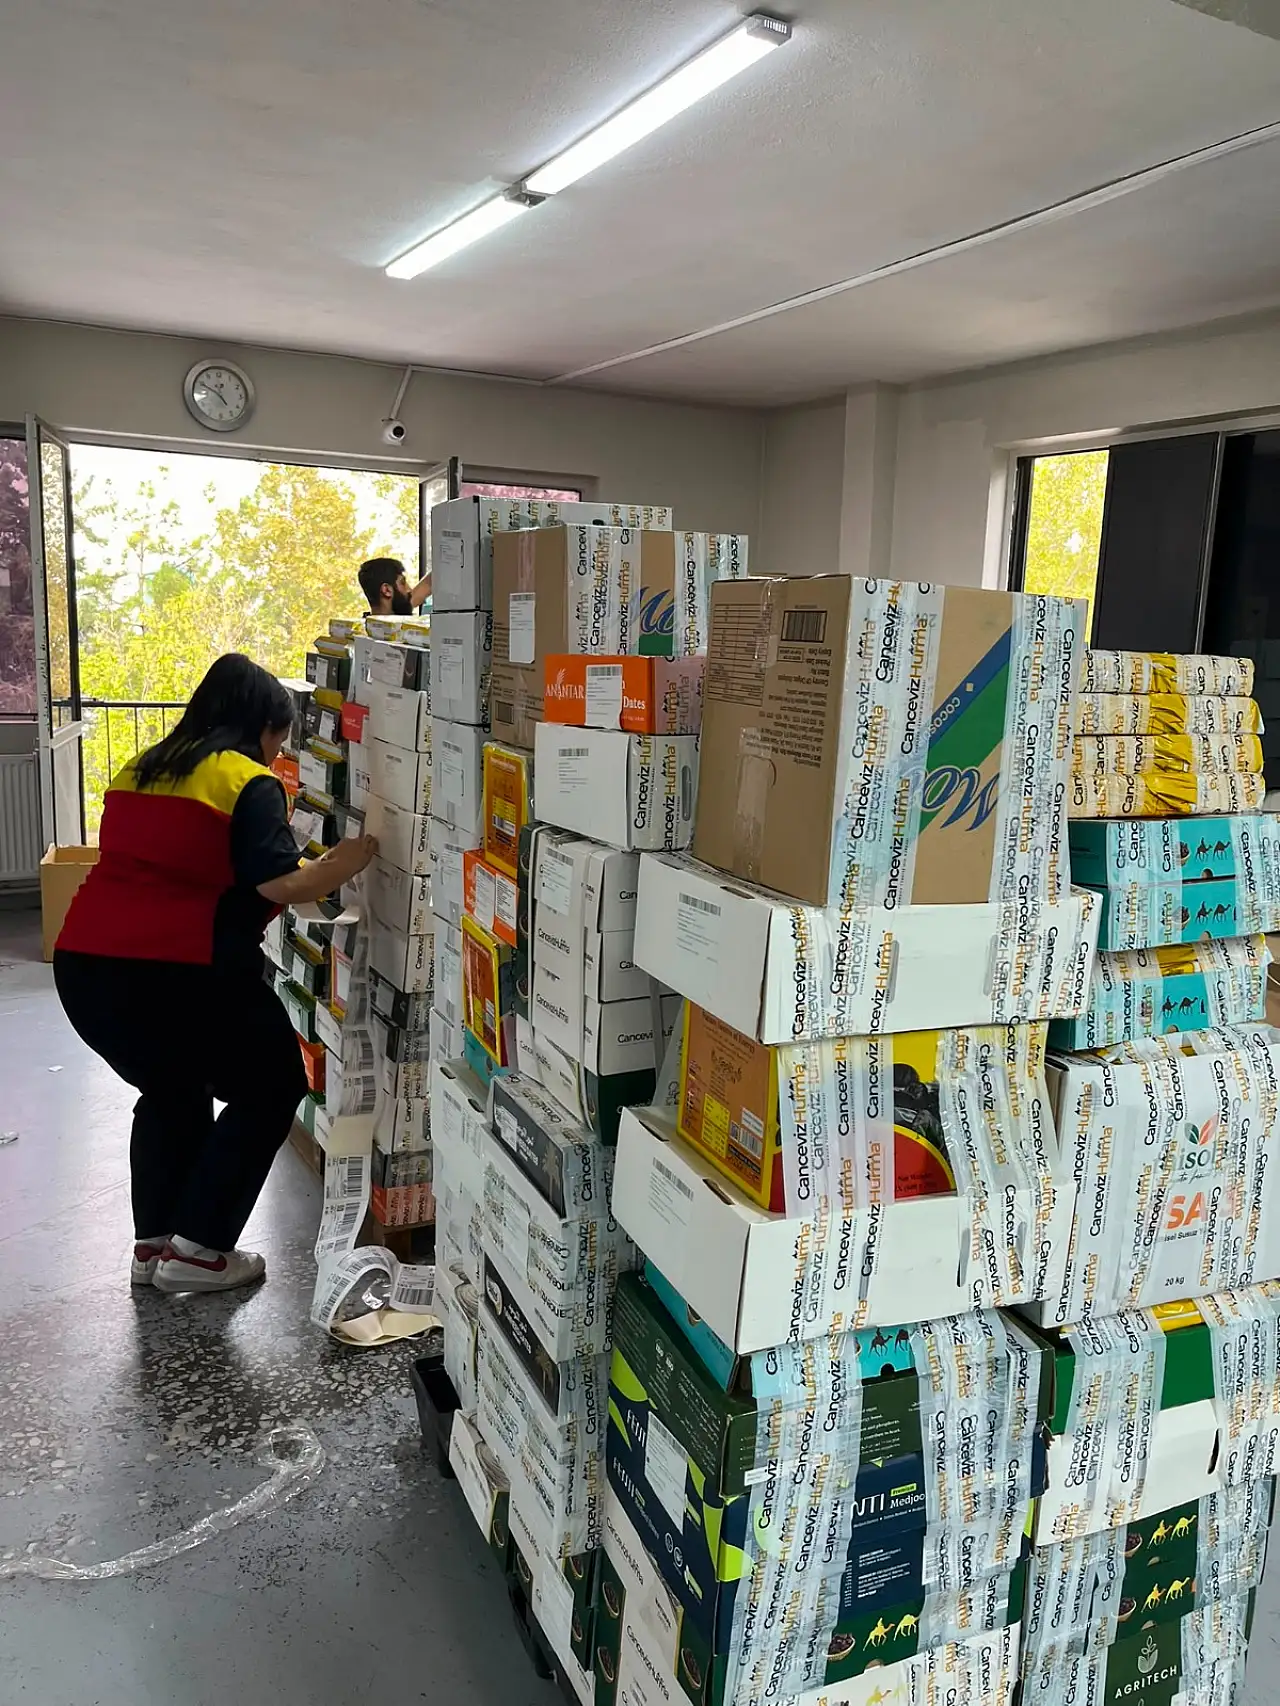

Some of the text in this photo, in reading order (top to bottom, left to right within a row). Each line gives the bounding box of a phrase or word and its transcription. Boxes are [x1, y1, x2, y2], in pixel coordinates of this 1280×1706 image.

[901, 615, 928, 755] CancevizHurma
[1055, 628, 1075, 759] CancevizHurma
[884, 778, 911, 911] CancevizHurma
[1048, 782, 1066, 906] CancevizHurma
[793, 1064, 811, 1200] CancevizHurma
[1090, 1126, 1113, 1237] CancevizHurma
[833, 1158, 855, 1291] CancevizHurma
[861, 1142, 882, 1277] CancevizHurma
[1114, 1664, 1178, 1699] AGRITECH
